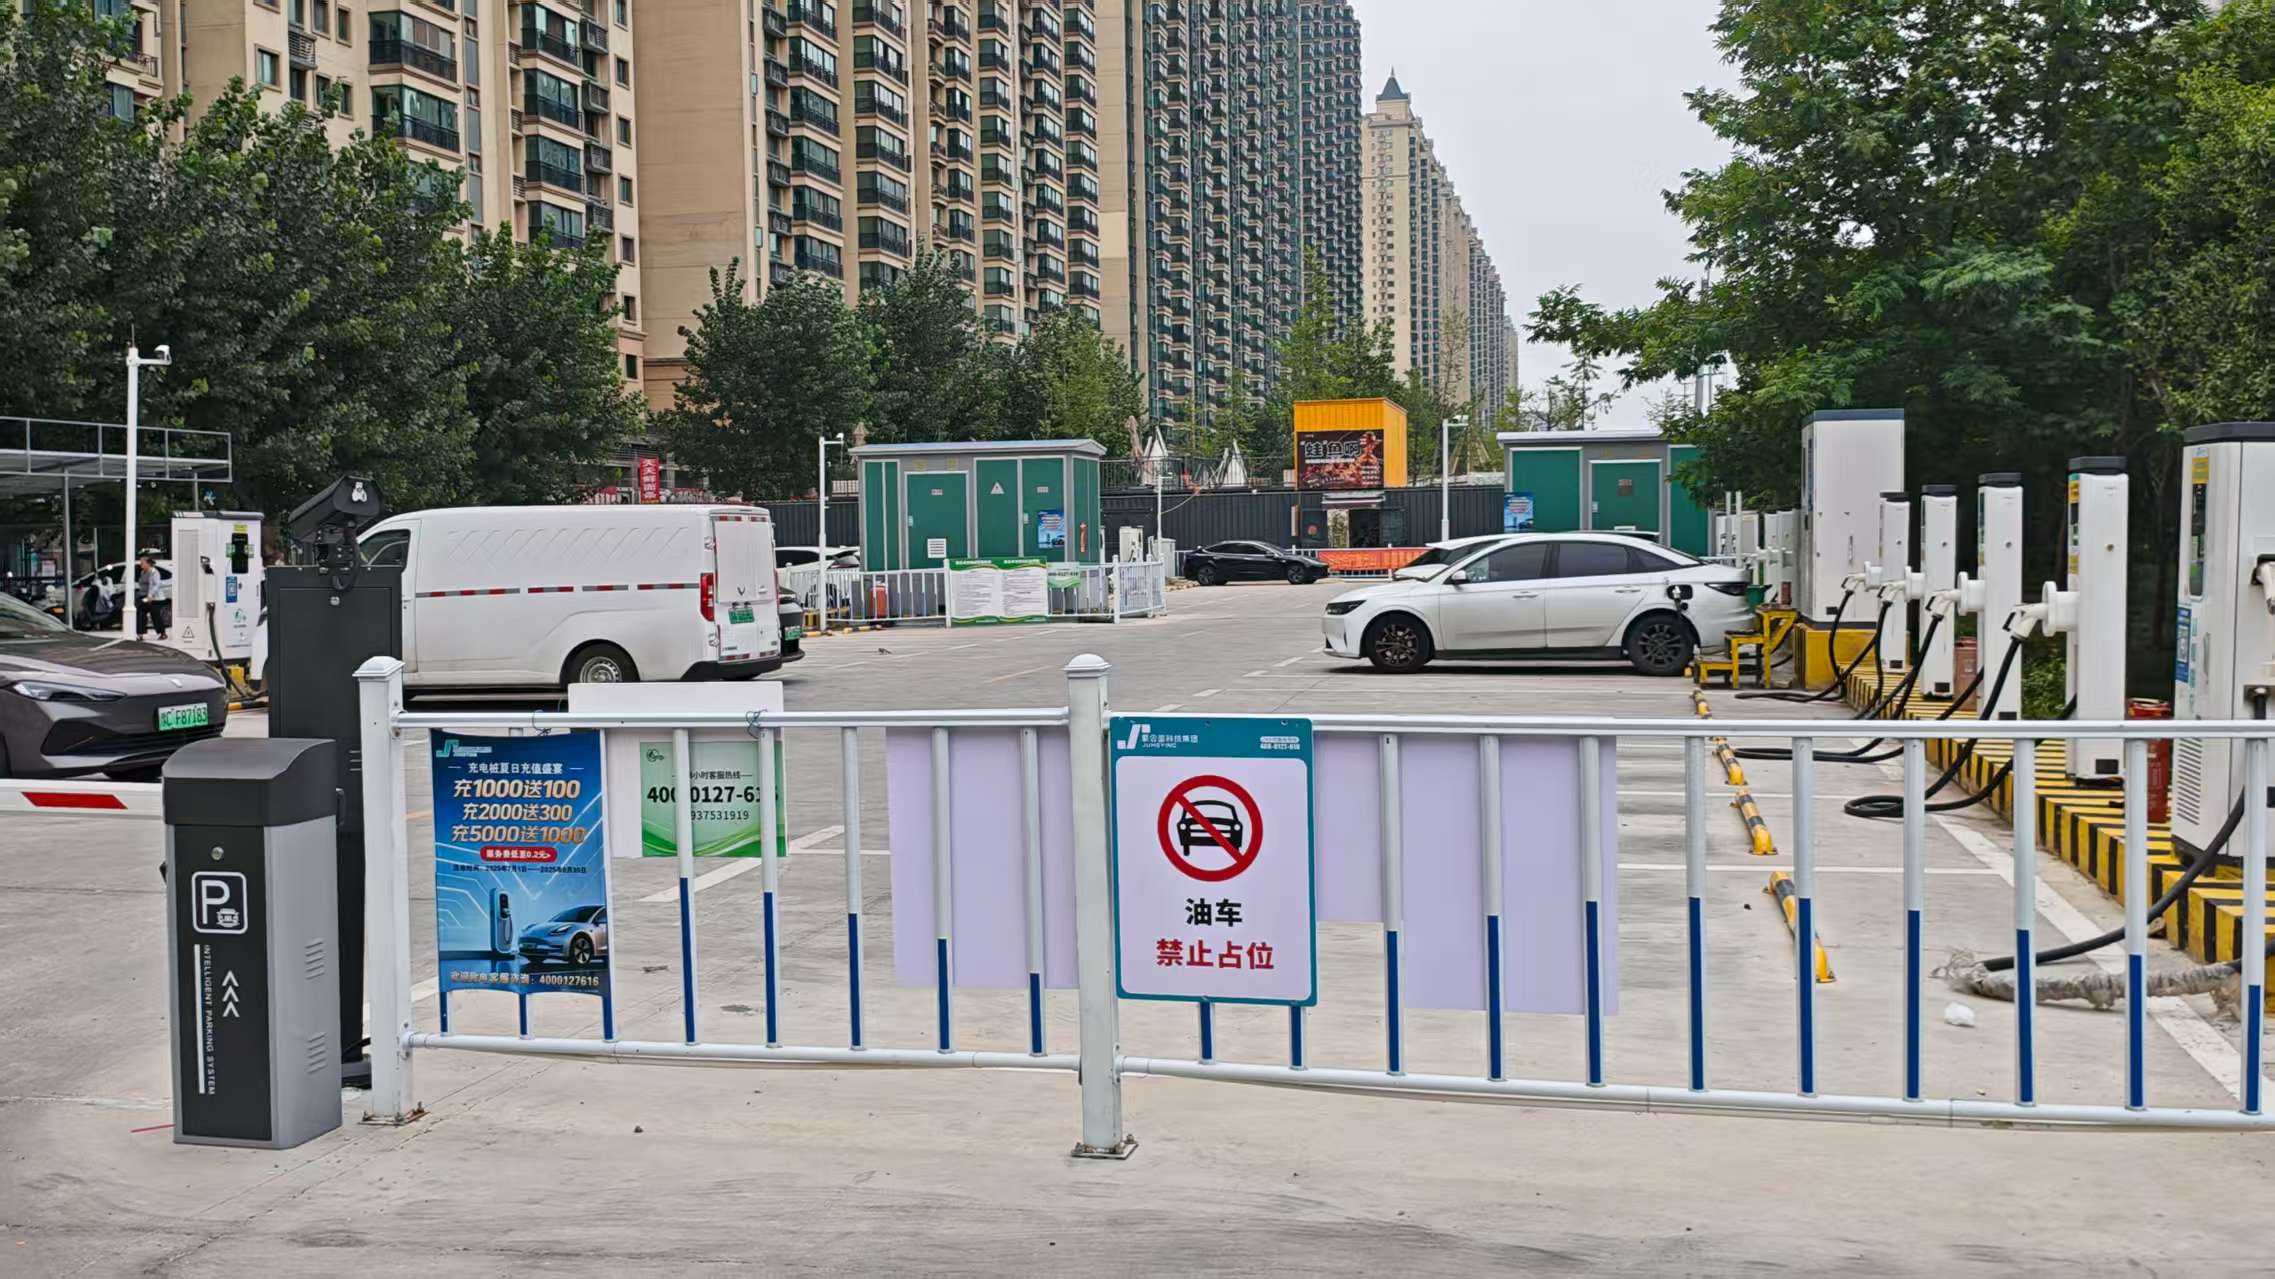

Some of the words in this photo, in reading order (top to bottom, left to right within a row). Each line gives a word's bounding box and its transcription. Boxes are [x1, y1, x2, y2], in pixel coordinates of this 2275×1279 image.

[468, 762, 563, 774] 充电桩夏日充值盛宴
[453, 779, 581, 798] 充1000送100
[462, 803, 573, 821] 充2000送300
[451, 824, 587, 844] 充5000送1000
[201, 879, 231, 925] P
[1185, 897, 1243, 927] 油车
[1156, 938, 1275, 970] 禁止占位
[203, 944, 212, 1005] INTELLIGENT
[539, 974, 600, 986] 4000127616
[205, 1009, 214, 1052] PARKING
[206, 1055, 216, 1095] SYSTEM
